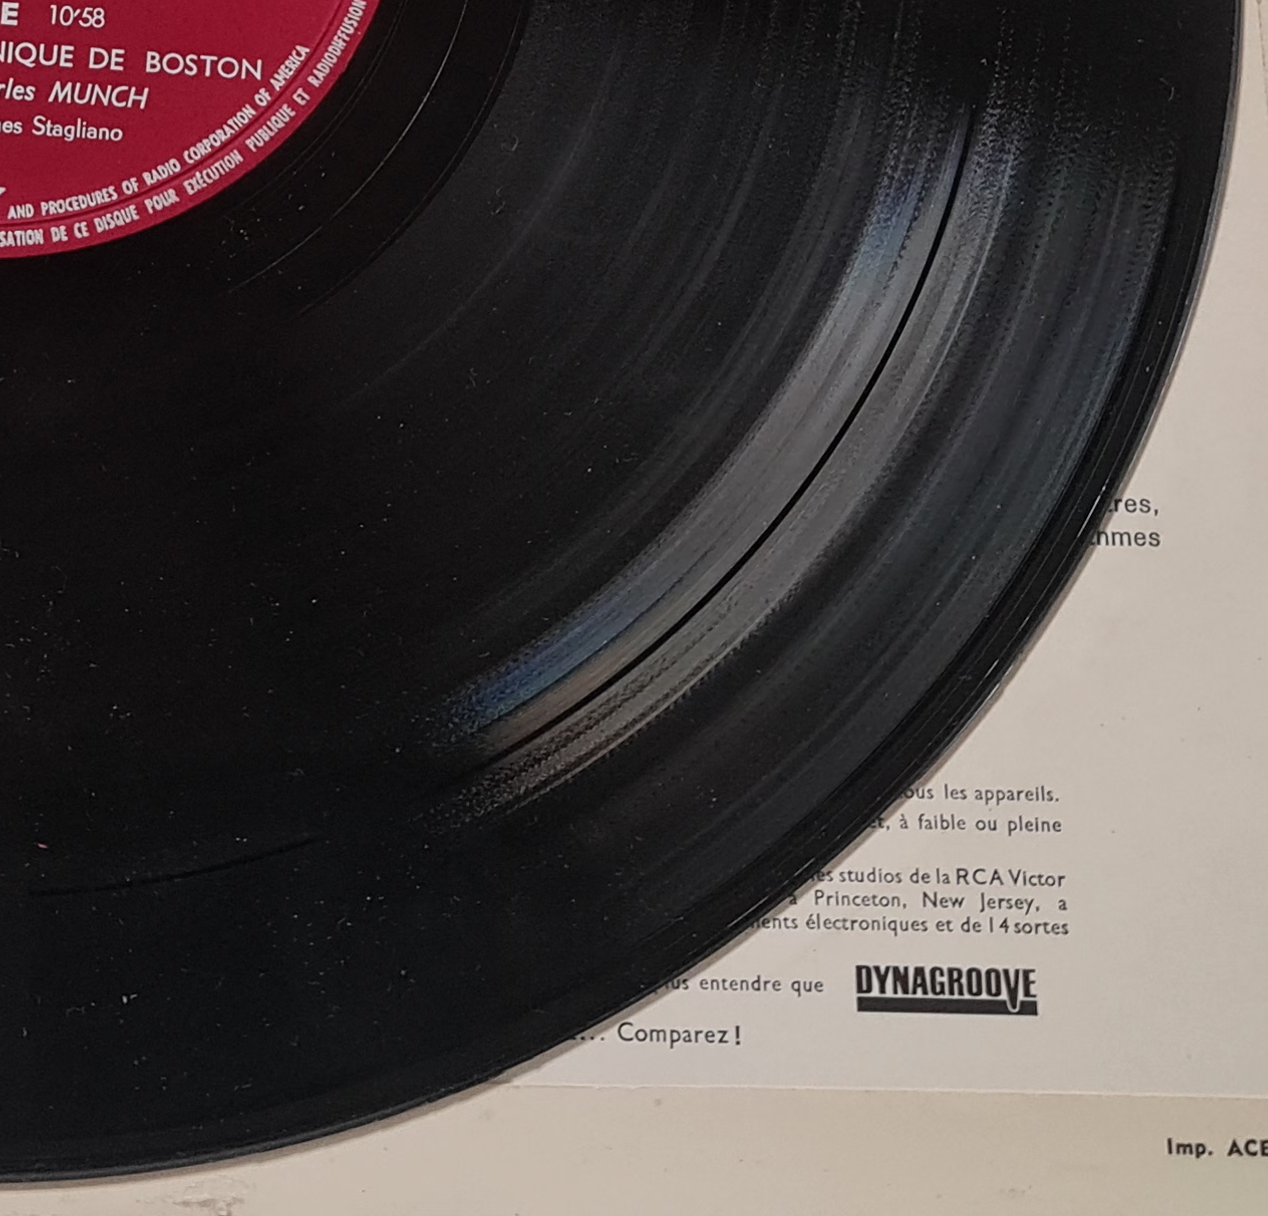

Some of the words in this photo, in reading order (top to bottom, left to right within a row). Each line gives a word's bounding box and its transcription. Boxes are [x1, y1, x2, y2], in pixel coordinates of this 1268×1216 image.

[88, 47, 125, 71] DE
[145, 50, 263, 81] BOSTON
[47, 80, 149, 110] MUNCH
[7, 203, 34, 220] AND
[40, 186, 118, 216] PROCEDURES
[121, 177, 139, 196] OF
[142, 158, 181, 186] RADIO
[183, 103, 257, 165] CORPORATION
[254, 87, 272, 107] OF
[269, 44, 310, 91] AMERICA
[31, 115, 123, 142] Stagliano
[50, 225, 69, 242] DE
[73, 221, 90, 239] CE
[93, 205, 140, 233] DISQUE
[144, 188, 180, 215] POUR
[182, 149, 244, 196] EXÉCUTION
[245, 103, 297, 152] PUBLIQUE
[292, 87, 311, 107] ET
[943, 783, 968, 801] les
[974, 784, 1060, 807] appareils.
[899, 813, 909, 830] à
[917, 812, 967, 831] faible
[974, 819, 998, 832] ou
[1007, 814, 1062, 837] pleine
[839, 866, 903, 884] studios
[909, 867, 931, 885] de
[935, 867, 951, 885] la
[955, 867, 1005, 886] RCA
[1007, 868, 1066, 888] Victor
[814, 889, 907, 910] Princeton,
[922, 890, 966, 909] New
[979, 891, 1040, 916] Jersey,
[1057, 898, 1068, 911] a
[805, 912, 929, 938] électroniques
[935, 919, 954, 933] et
[960, 915, 982, 934] de
[1013, 921, 1070, 936] sortes
[699, 974, 782, 992] entendre
[790, 980, 824, 998] que
[856, 965, 1038, 1012] DYNAGROOVE
[1166, 1137, 1214, 1160] Imp.
